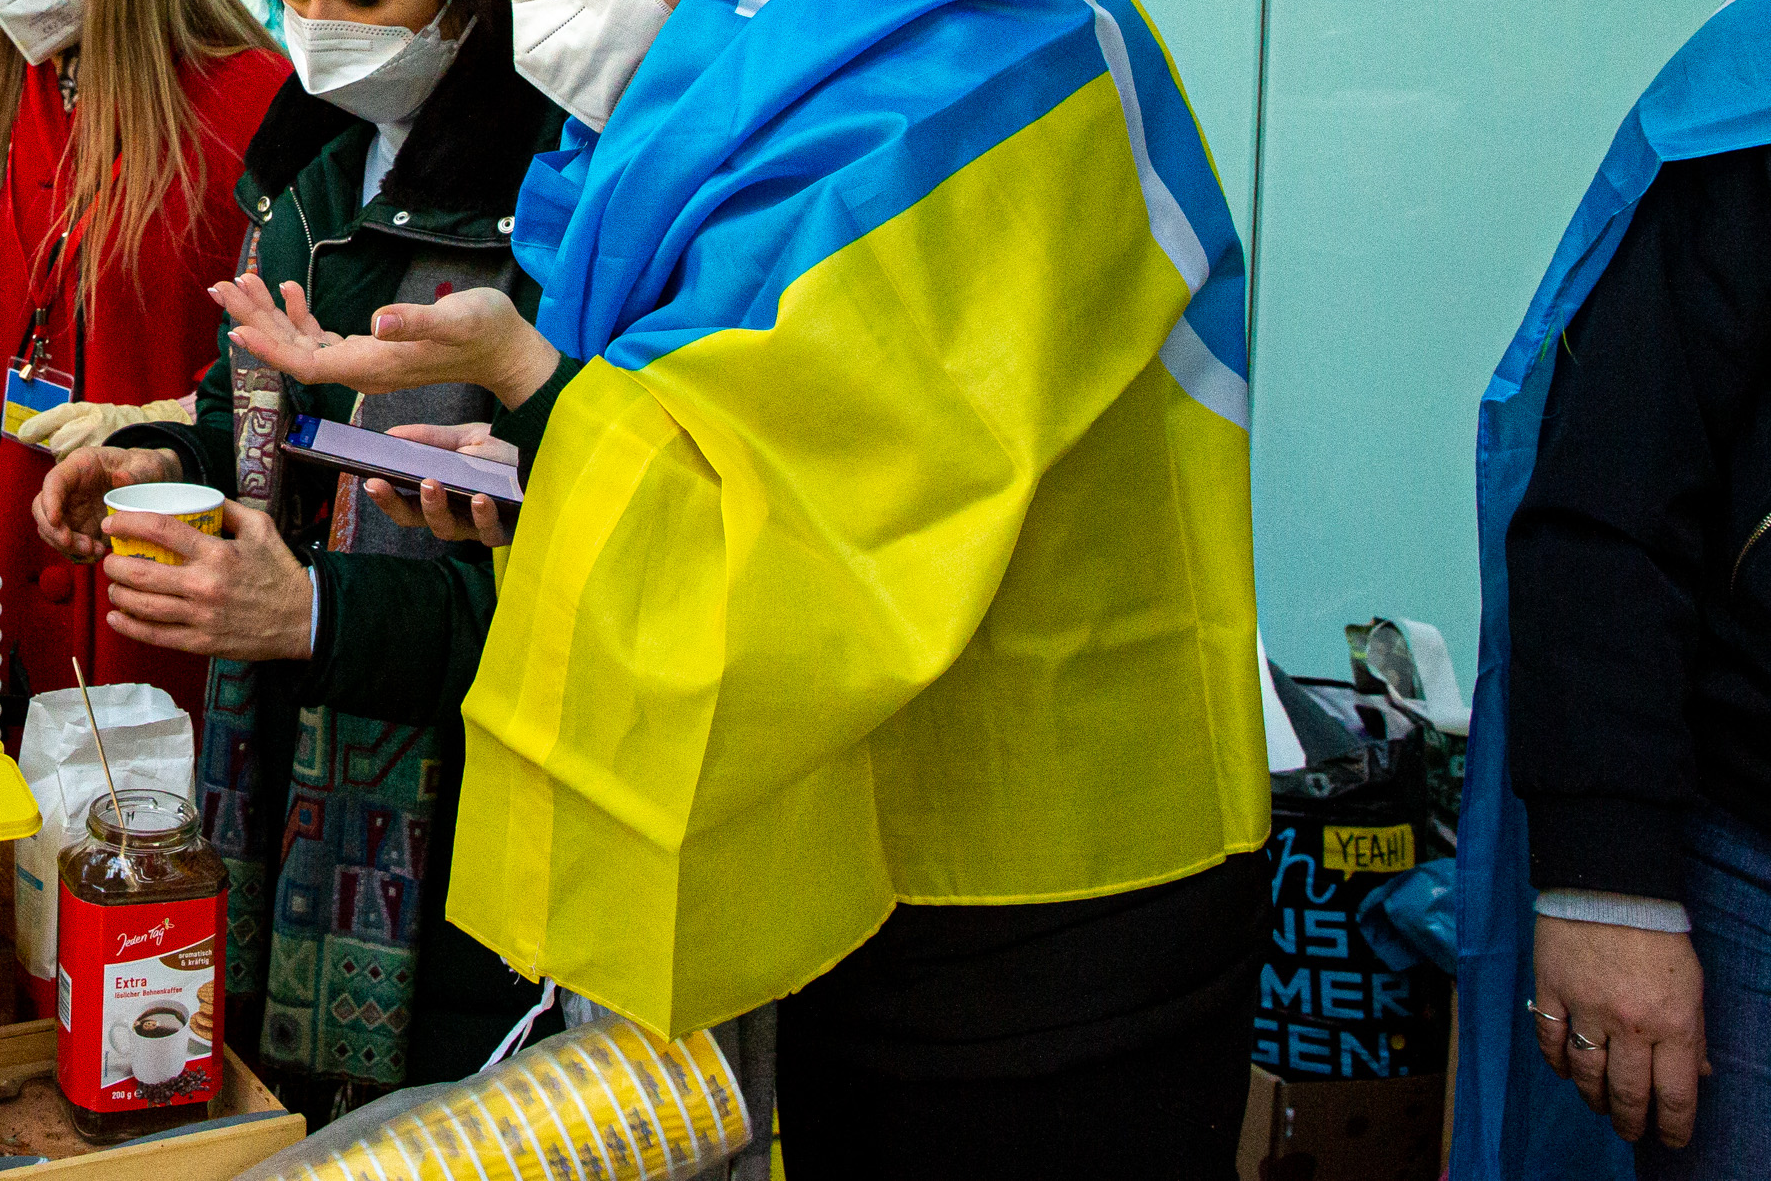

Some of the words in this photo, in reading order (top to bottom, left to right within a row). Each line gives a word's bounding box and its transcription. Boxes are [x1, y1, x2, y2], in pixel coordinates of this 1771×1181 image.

[1335, 830, 1407, 868] YEAH!
[116, 932, 148, 957] Jeden
[148, 923, 166, 946] Tag
[178, 948, 213, 959] aromatisch
[188, 957, 210, 967] kräftig
[115, 976, 148, 990] Extra
[114, 990, 140, 1000] löslicher
[142, 986, 184, 997] Bohnenkaffee
[111, 1091, 126, 1100] 200
